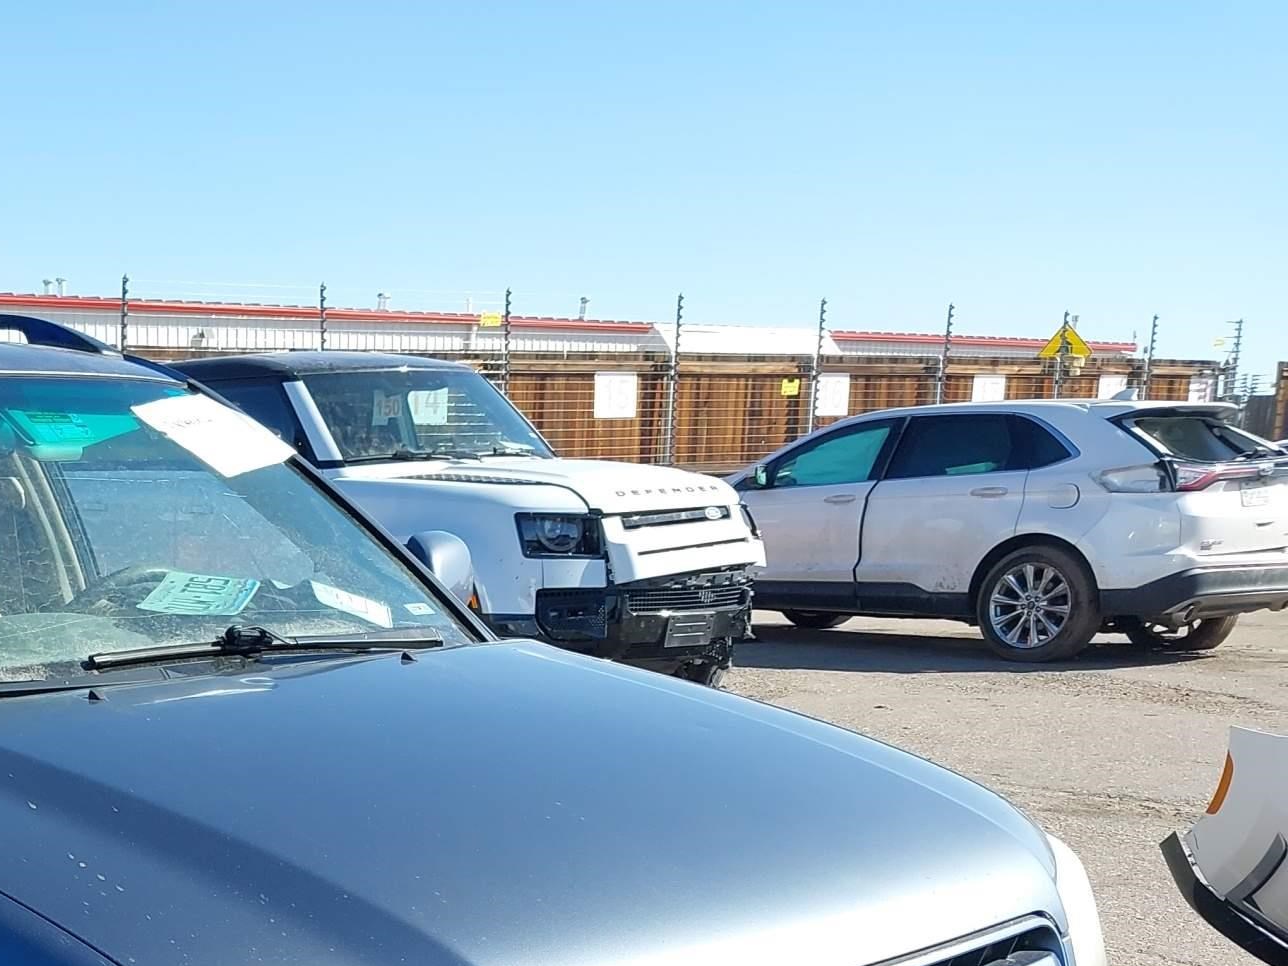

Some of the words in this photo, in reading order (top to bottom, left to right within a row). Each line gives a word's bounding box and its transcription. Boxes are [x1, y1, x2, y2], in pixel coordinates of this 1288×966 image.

[375, 398, 402, 417] 150
[412, 391, 441, 416] 14
[614, 484, 720, 497] DEFENDER
